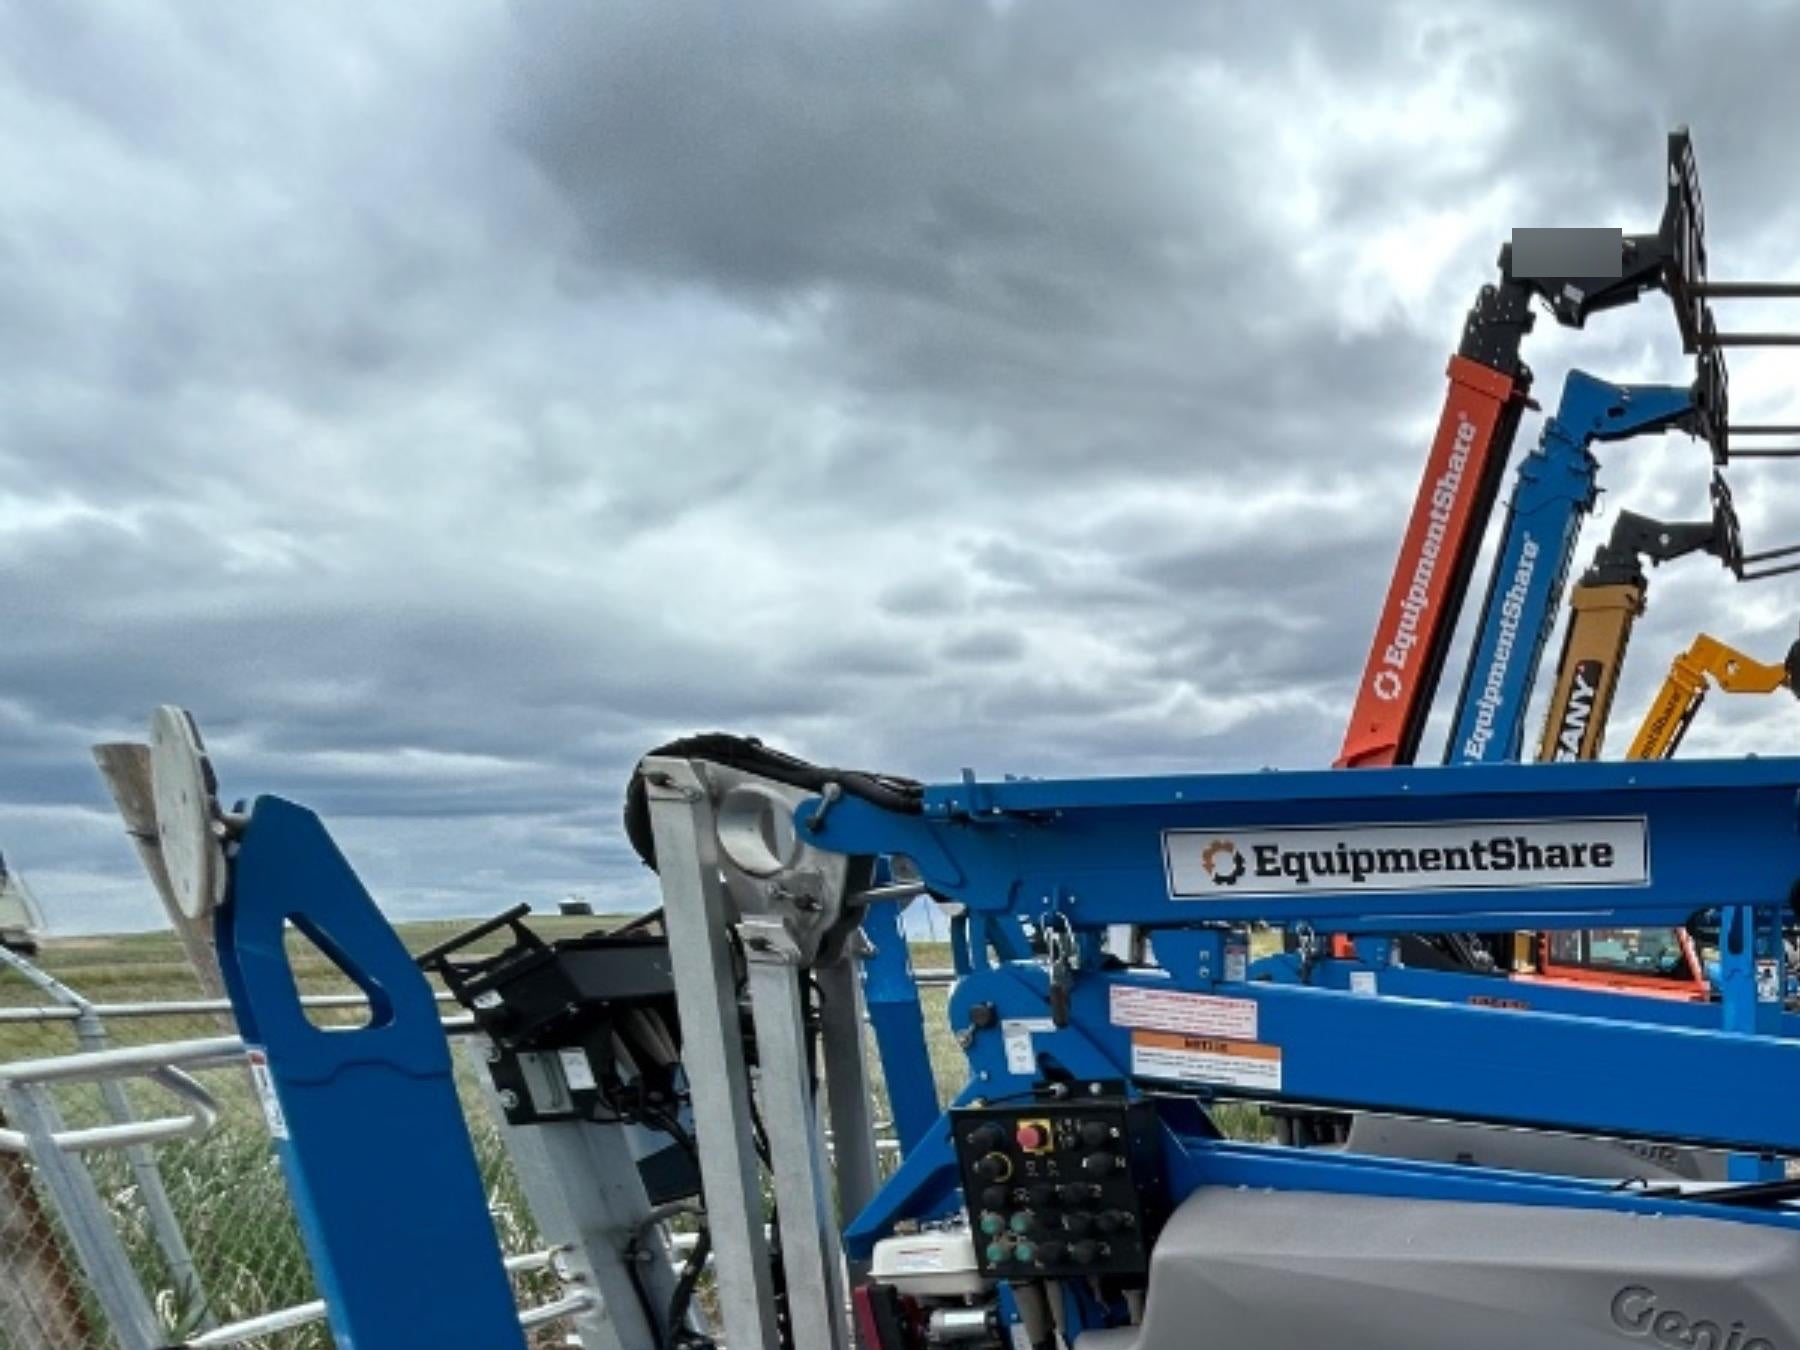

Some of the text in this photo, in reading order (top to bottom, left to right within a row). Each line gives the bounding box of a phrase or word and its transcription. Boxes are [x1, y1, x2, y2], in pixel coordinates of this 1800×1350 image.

[1383, 419, 1476, 669] EquipmentShare
[1464, 540, 1540, 761] EquipmentShare
[1252, 836, 1614, 884] EquipmentShare
